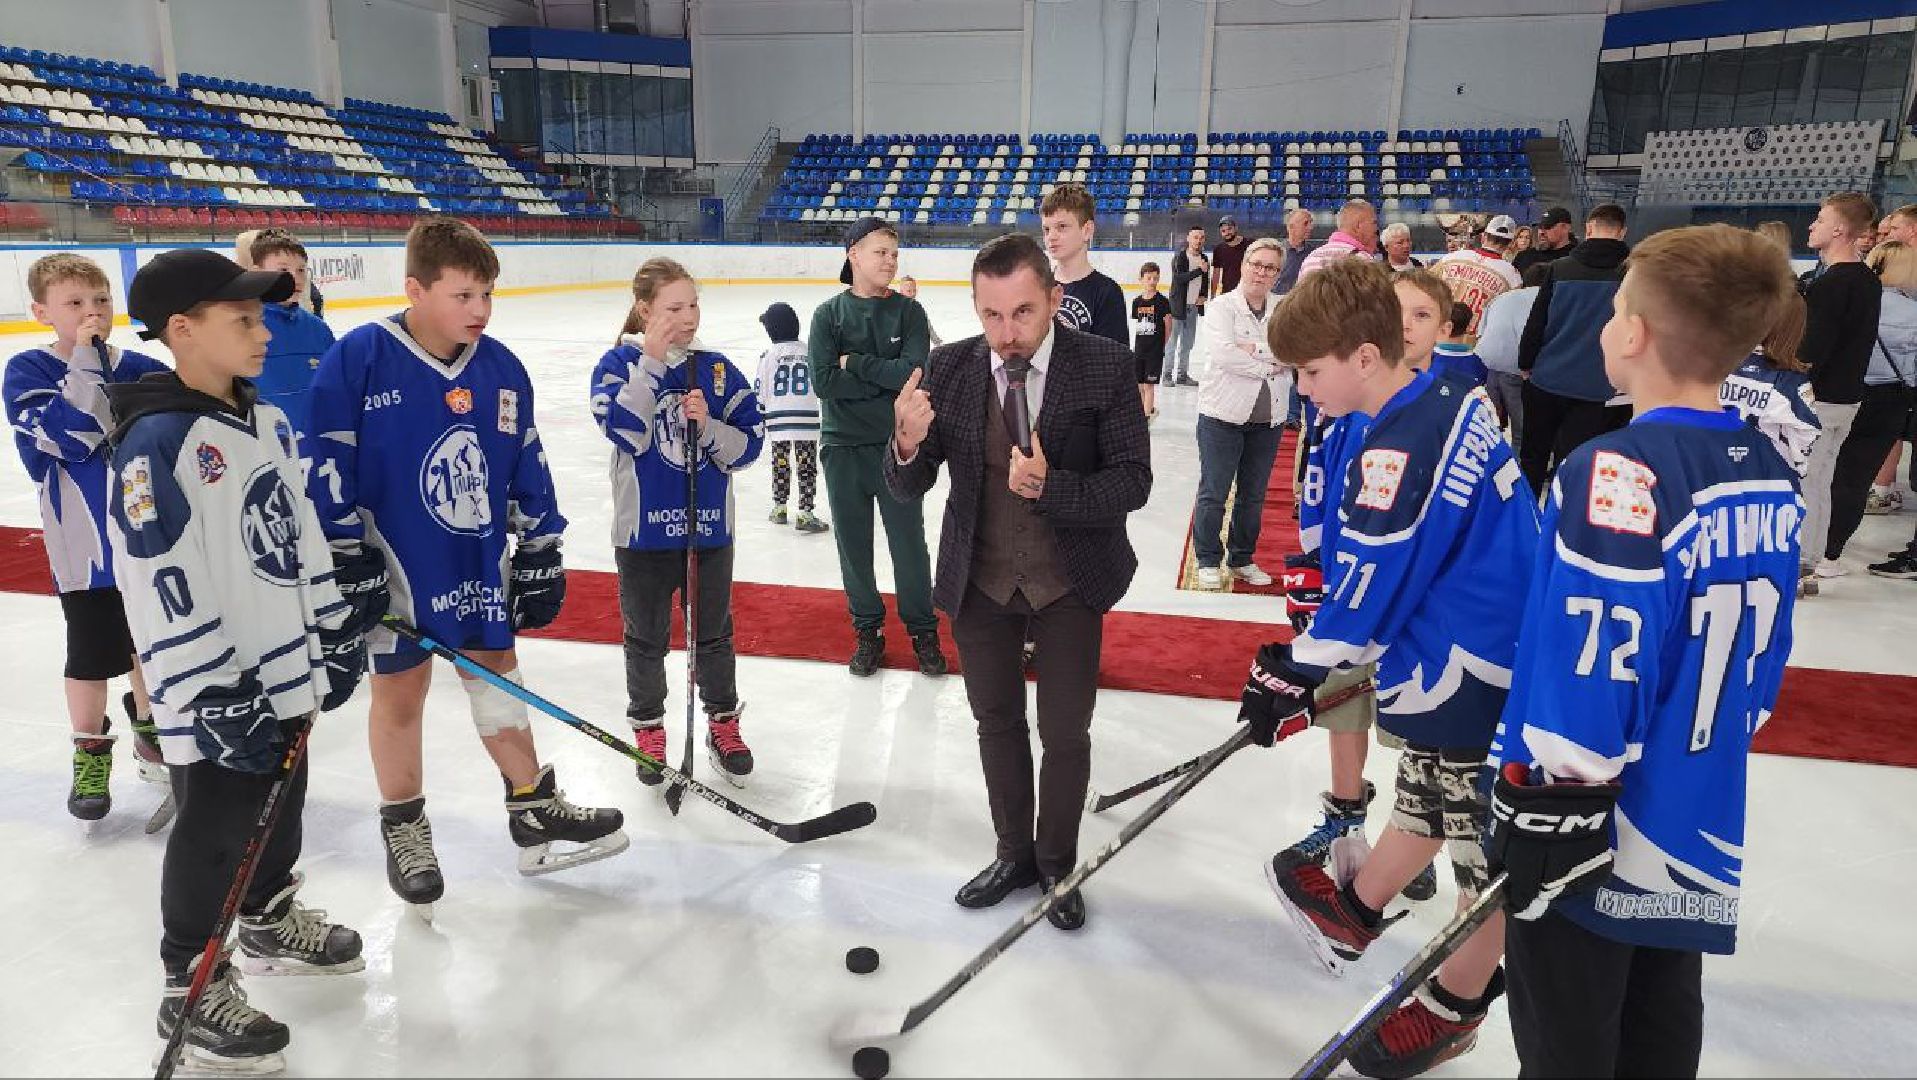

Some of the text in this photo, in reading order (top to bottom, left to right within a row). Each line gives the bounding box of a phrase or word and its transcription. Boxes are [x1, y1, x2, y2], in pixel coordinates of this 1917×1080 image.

[773, 363, 809, 397] 88
[364, 389, 402, 411] 2005
[1333, 551, 1377, 611] 71
[1566, 596, 1644, 684] 72
[1492, 796, 1609, 834] CCM
